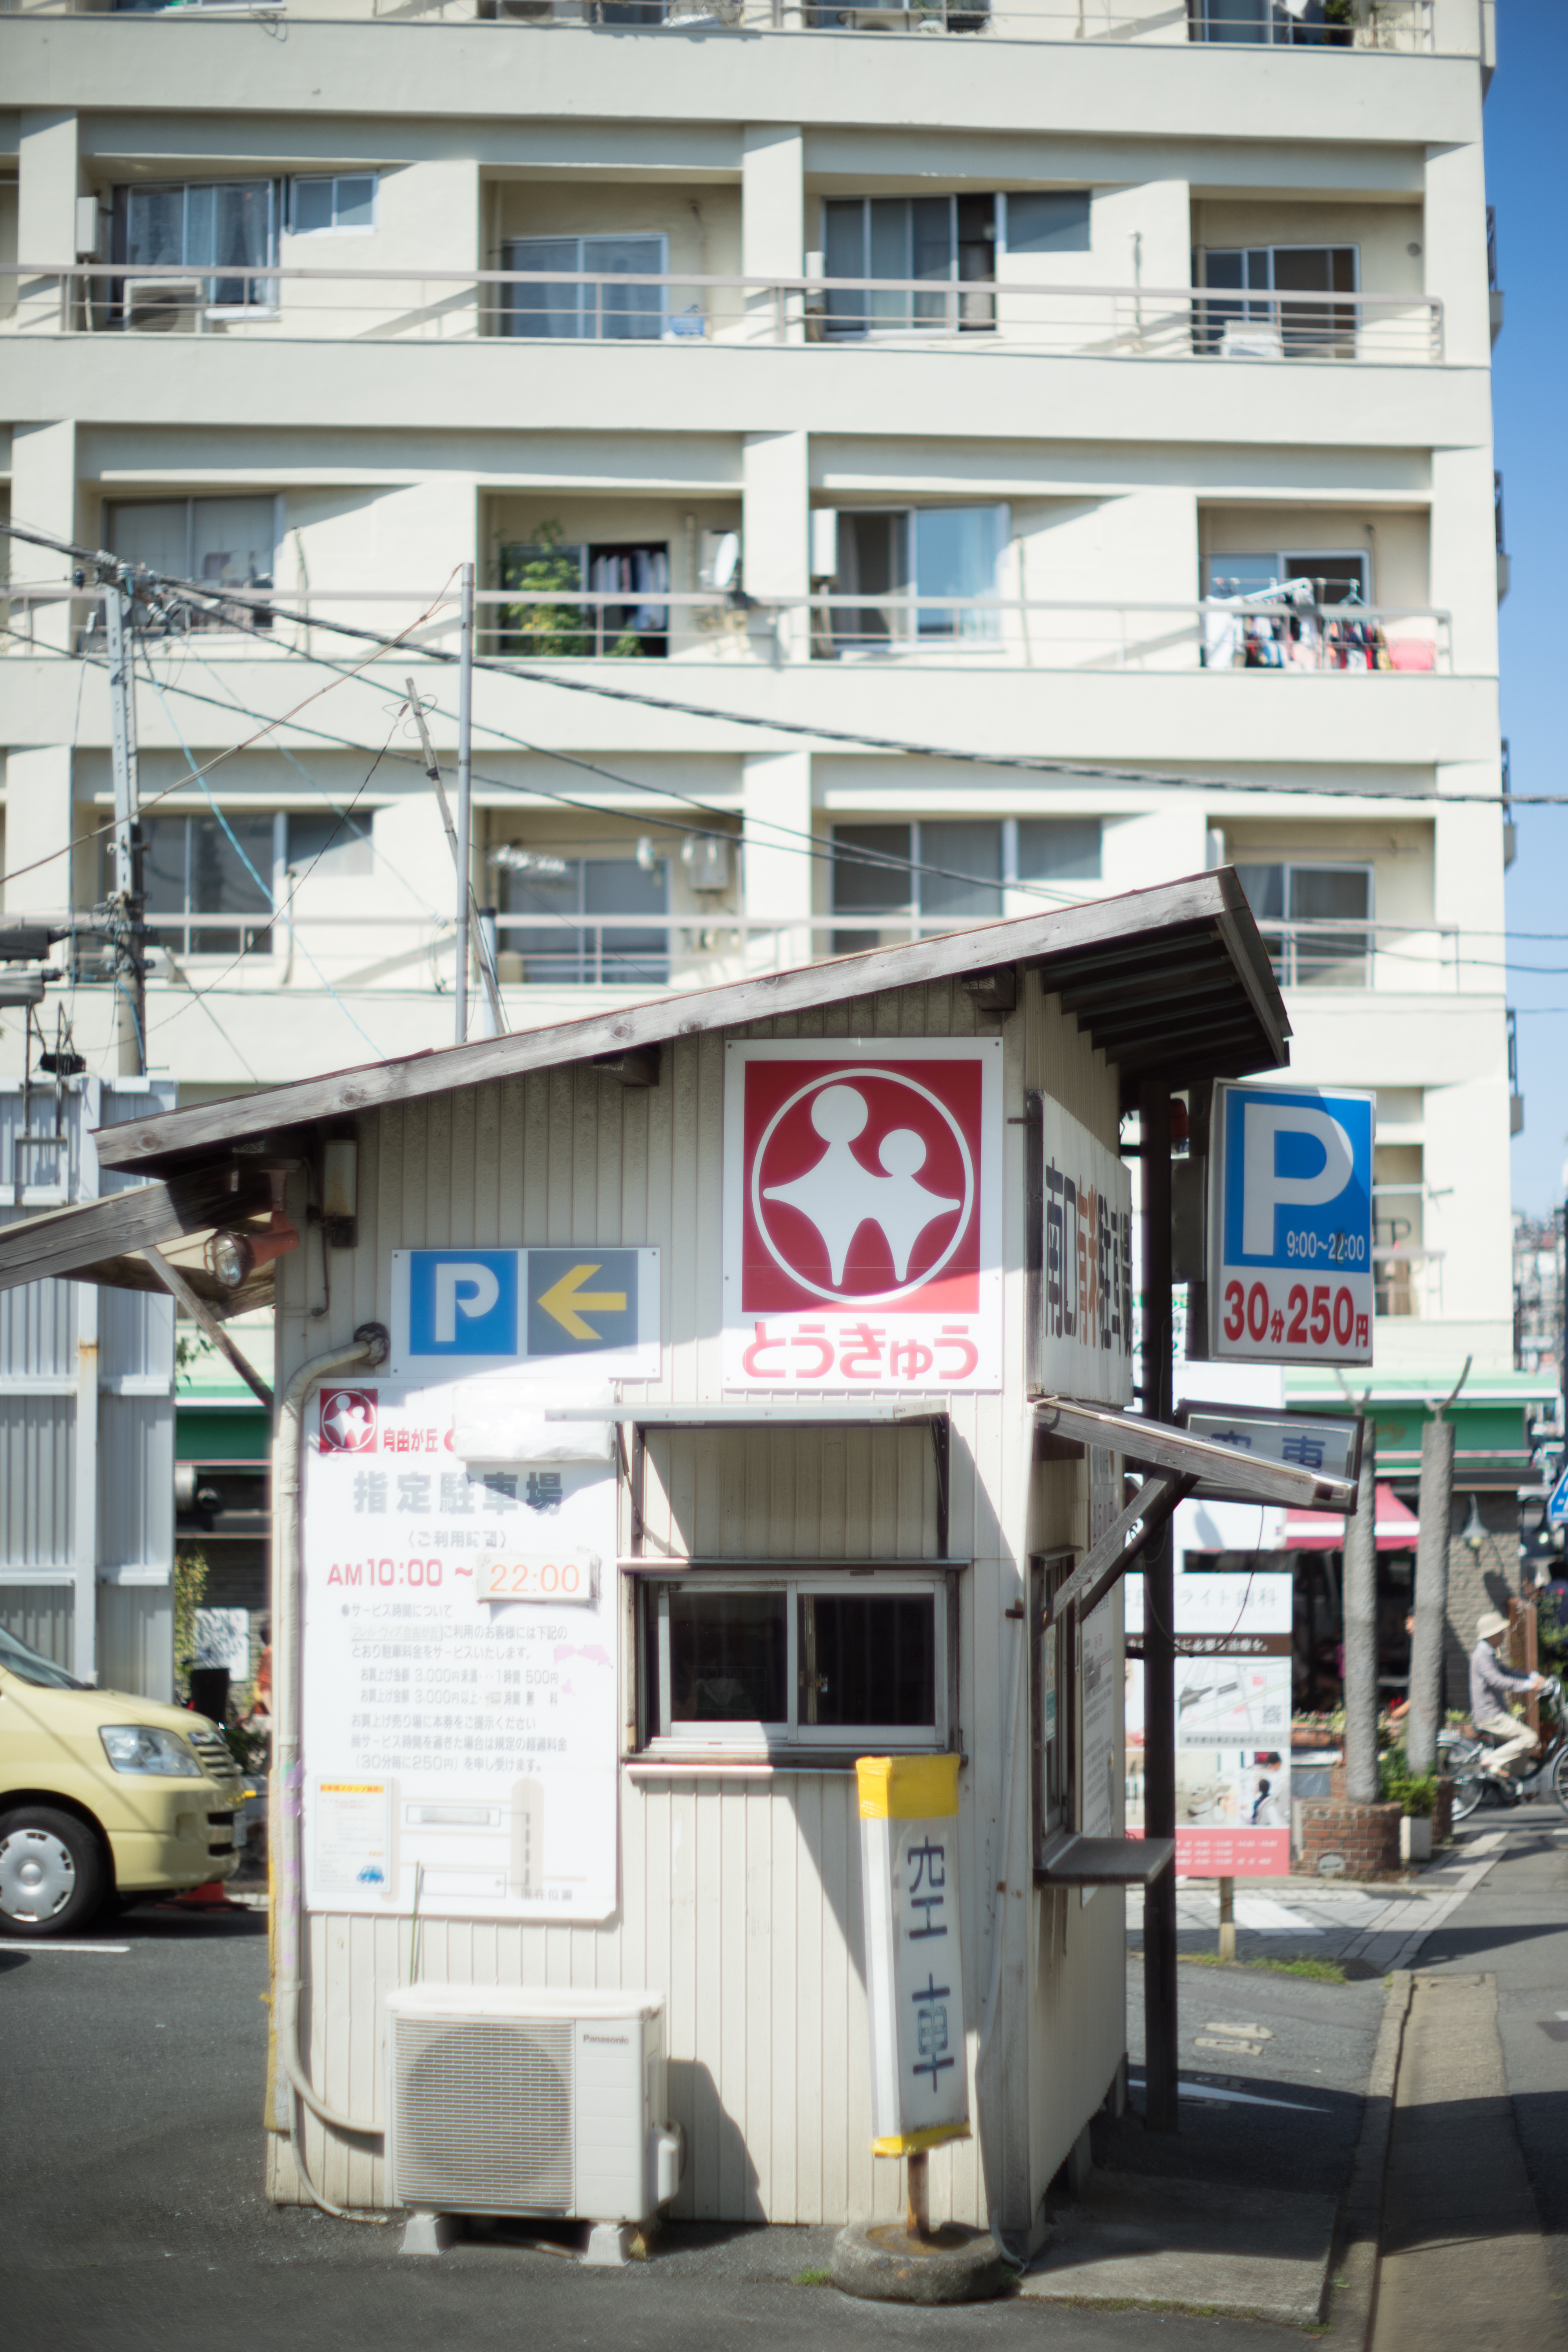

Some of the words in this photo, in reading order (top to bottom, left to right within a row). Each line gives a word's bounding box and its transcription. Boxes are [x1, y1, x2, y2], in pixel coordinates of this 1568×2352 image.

[1243, 1102, 1353, 1255] P
[436, 1263, 499, 1342] P
[1223, 1280, 1368, 1348] 30分250円
[742, 1321, 978, 1381] とうきゅう
[383, 1427, 438, 1453] 自由が丘
[354, 1471, 563, 1516] 指定駐車場
[327, 1558, 443, 1587] AM10:00
[490, 1564, 579, 1592] 22:00
[351, 1603, 453, 1618] サービス時間について
[526, 1669, 558, 1685] 500円
[908, 1836, 955, 2093] 空車
[583, 2034, 630, 2045] Panasonic
